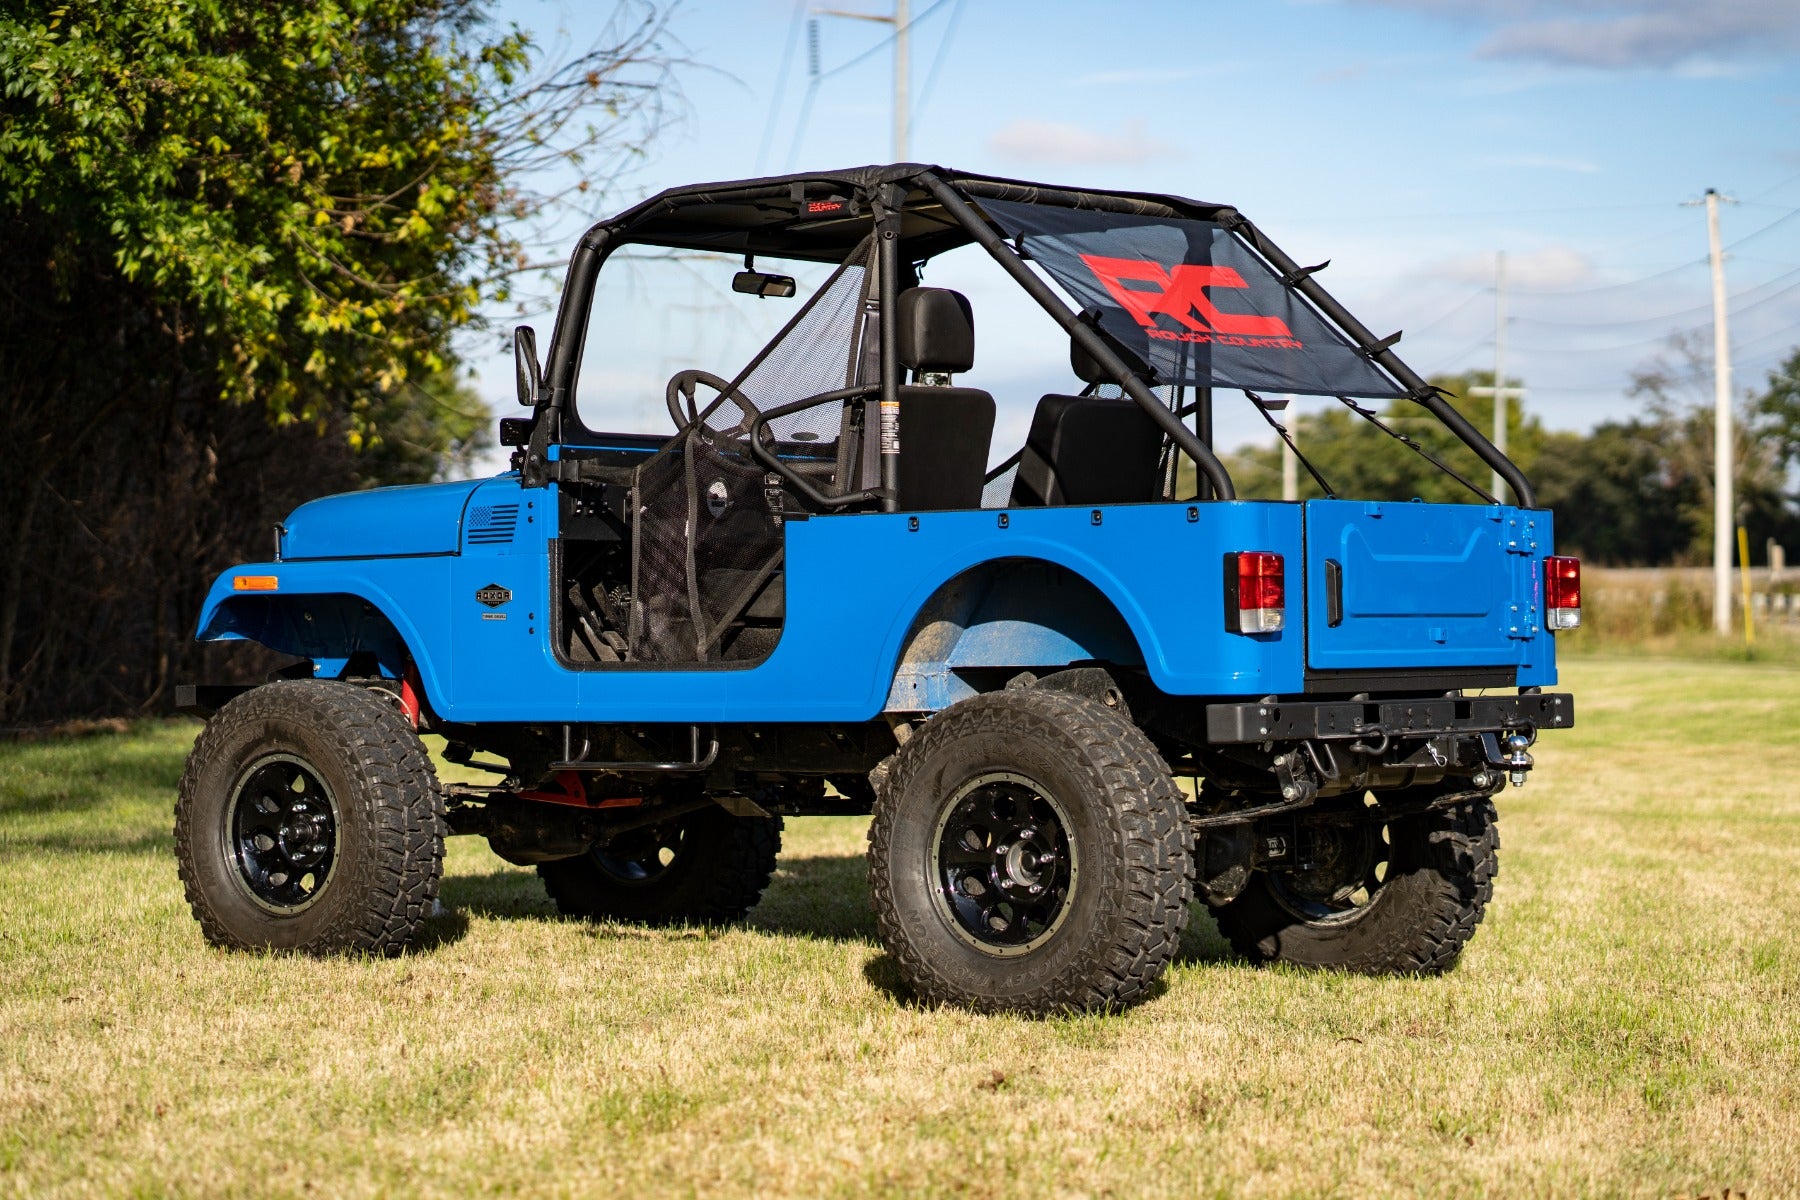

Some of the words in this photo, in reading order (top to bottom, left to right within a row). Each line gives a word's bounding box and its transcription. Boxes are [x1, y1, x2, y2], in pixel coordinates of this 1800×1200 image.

[808, 203, 841, 212] COUNTRY
[1144, 329, 1215, 344] ROUGH
[1216, 335, 1303, 350] COUNTRY
[476, 591, 510, 600] ROXOR
[998, 941, 1070, 988] MICKEY
